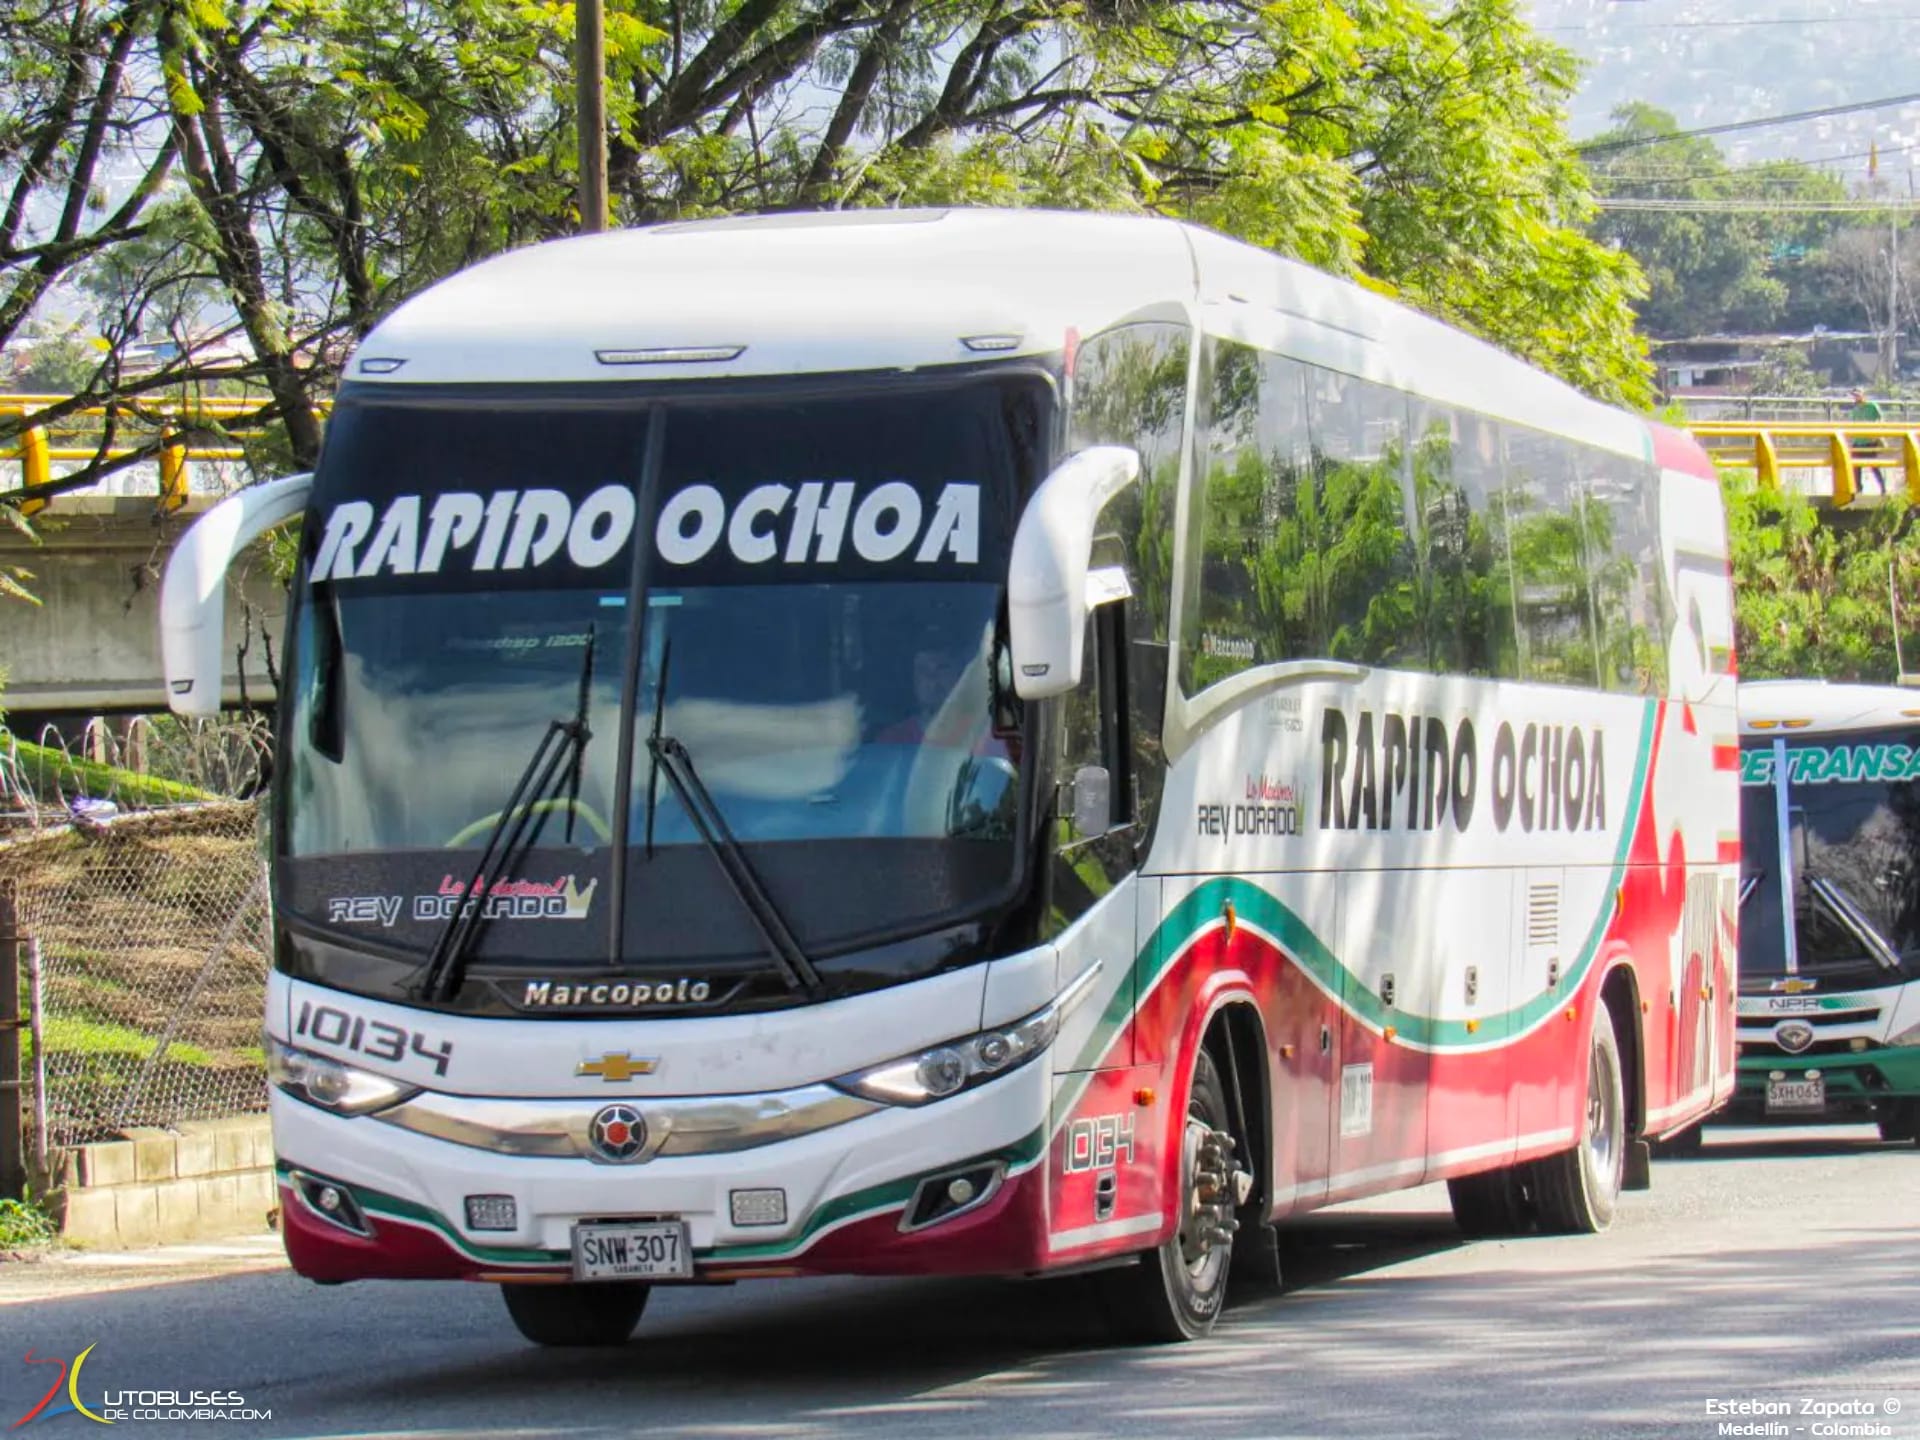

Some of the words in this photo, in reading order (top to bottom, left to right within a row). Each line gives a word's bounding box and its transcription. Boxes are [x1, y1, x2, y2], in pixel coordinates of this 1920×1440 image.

[308, 484, 636, 583] RAPIDO
[655, 482, 981, 565] OCHOA
[1320, 708, 1477, 833] RAPIDO
[1492, 720, 1607, 834] OCHOA
[1198, 804, 1231, 845] REY
[1235, 804, 1296, 836] DORADO
[329, 896, 404, 927] REY
[524, 978, 711, 1008] Marcopolo
[1768, 998, 1818, 1009] NPR
[296, 1001, 453, 1077] 10134
